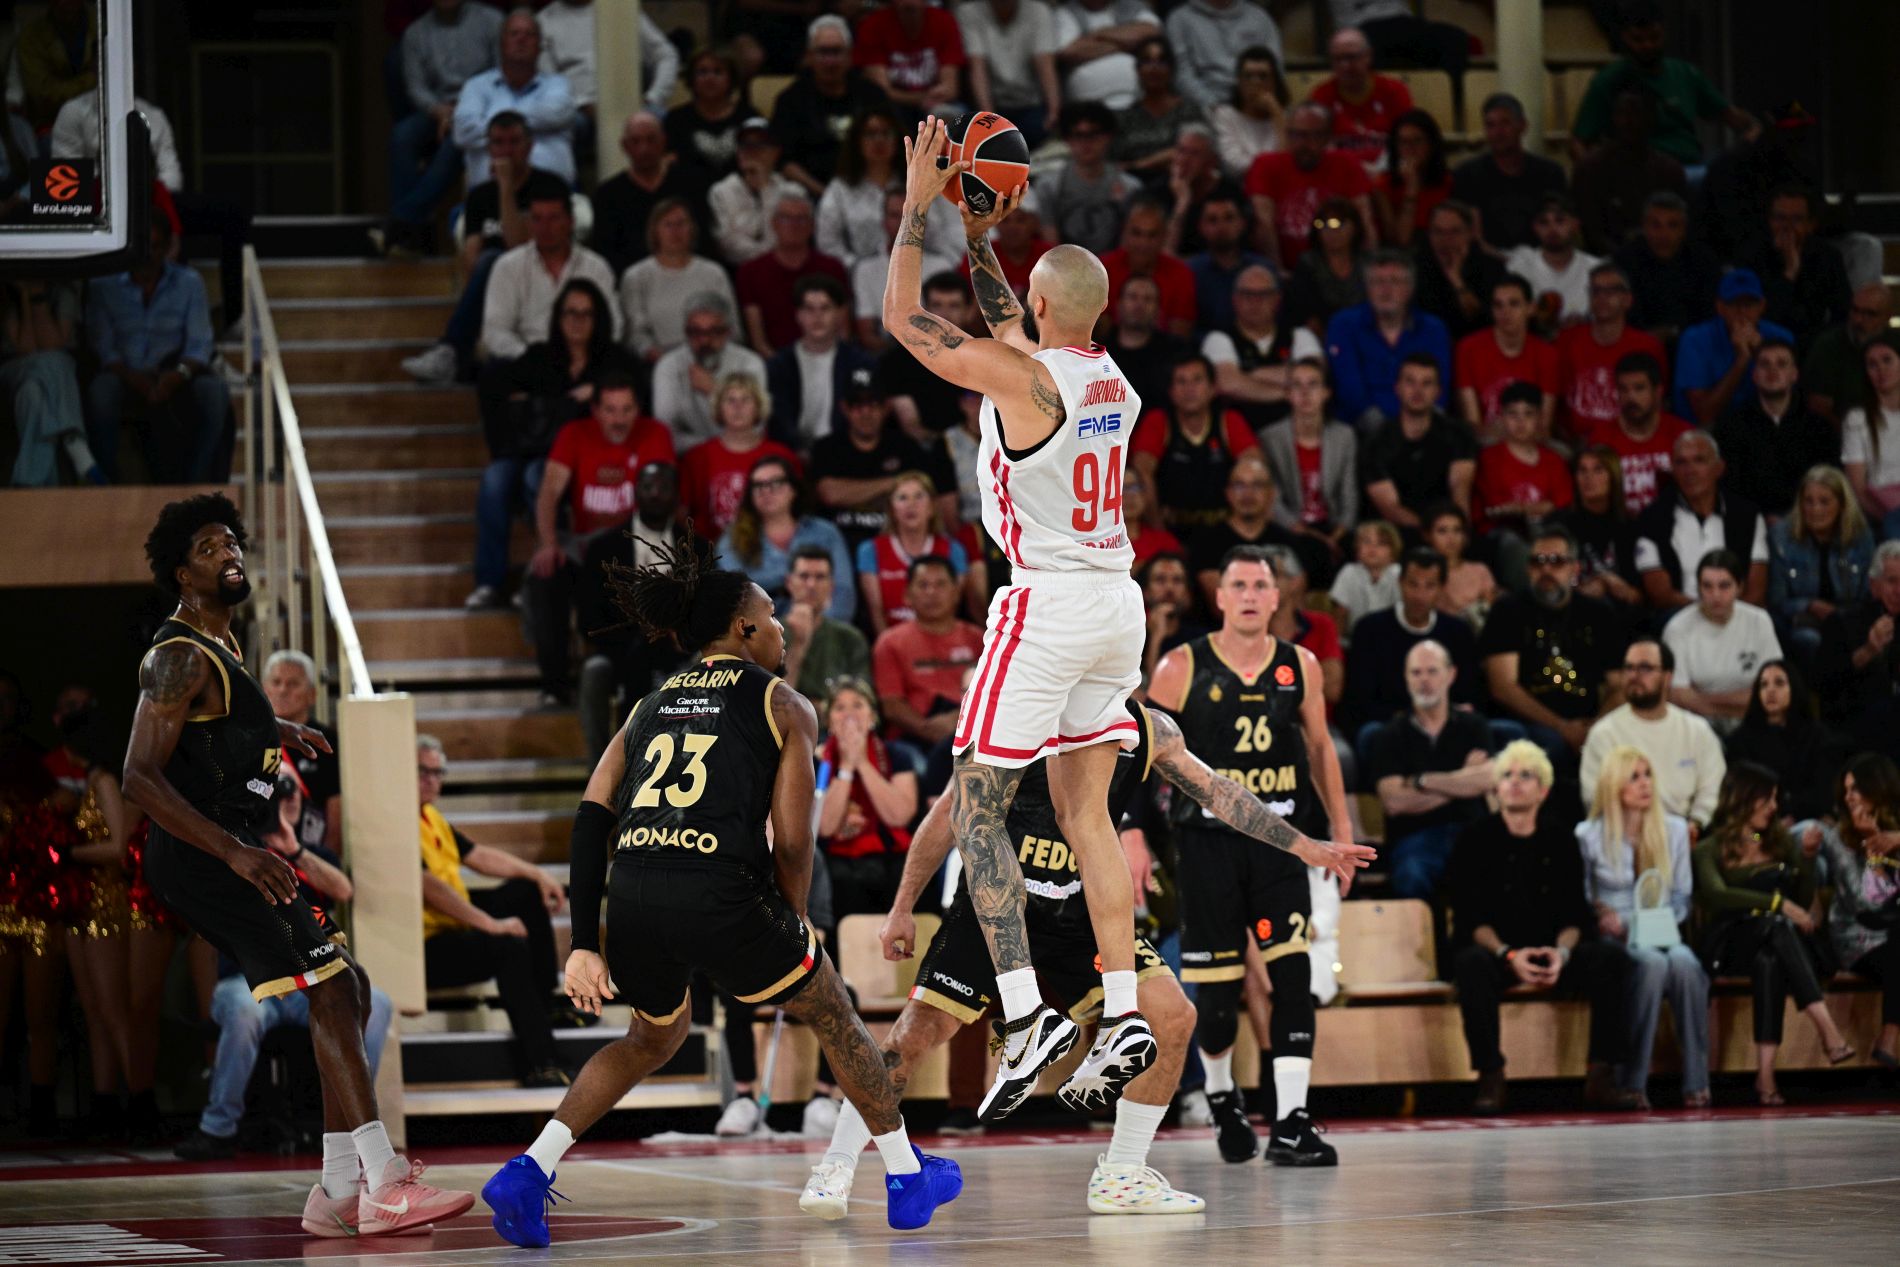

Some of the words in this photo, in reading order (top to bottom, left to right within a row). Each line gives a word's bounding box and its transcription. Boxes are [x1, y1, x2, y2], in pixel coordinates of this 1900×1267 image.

[1078, 413, 1121, 437] FMS
[1072, 445, 1122, 532] 94
[660, 669, 743, 691] BEGARIN
[1234, 715, 1272, 752] 26
[632, 733, 718, 808] 23
[618, 827, 718, 853] MONACO
